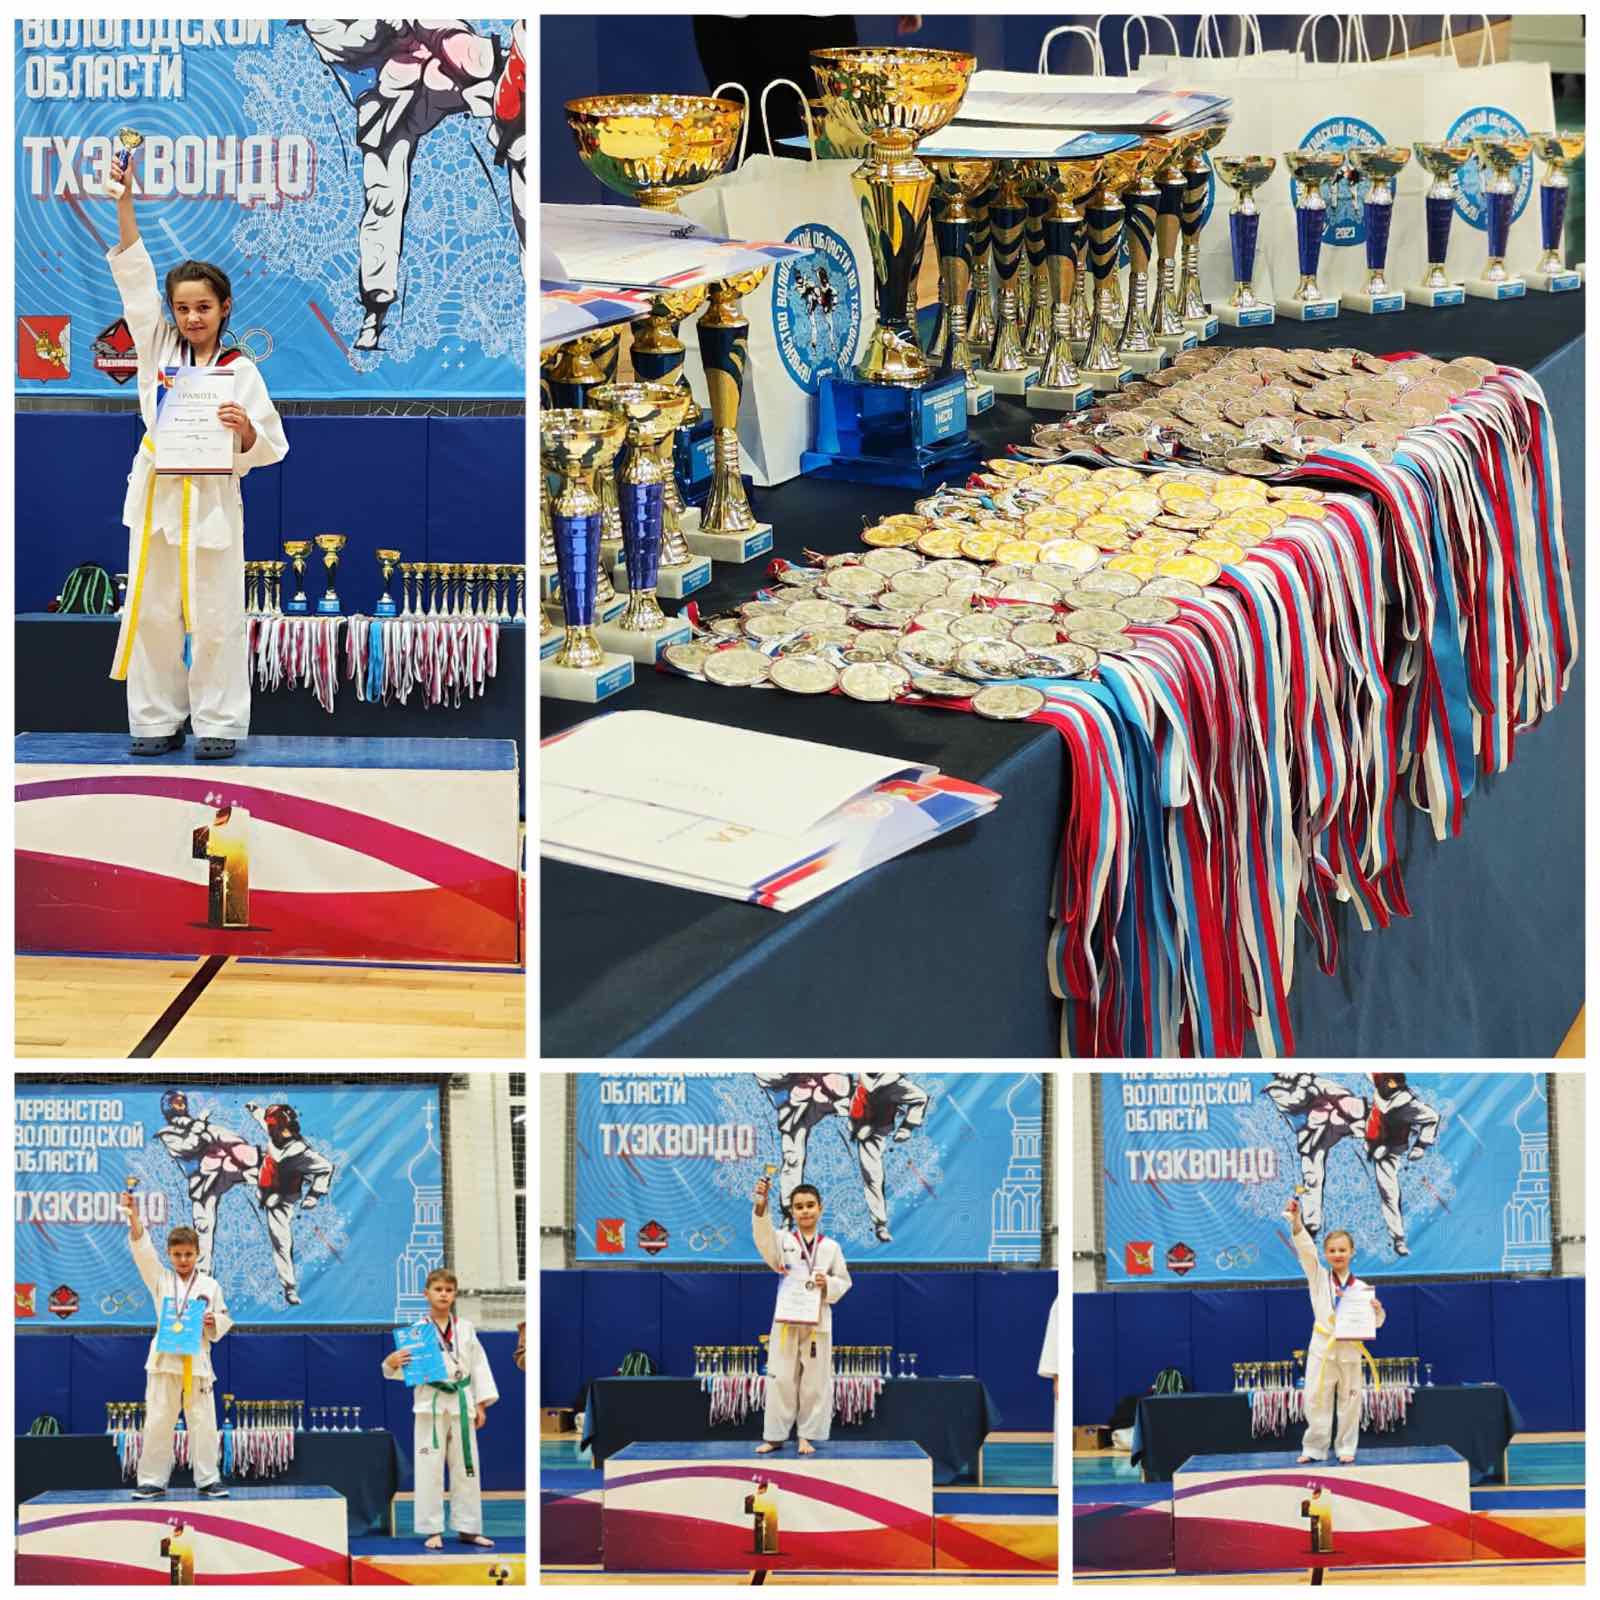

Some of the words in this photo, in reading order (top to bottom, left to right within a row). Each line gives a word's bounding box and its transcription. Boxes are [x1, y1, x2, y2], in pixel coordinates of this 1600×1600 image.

[25, 54, 184, 98] ОБЛАСТИ
[192, 805, 250, 928] 1
[600, 1081, 687, 1105] ОБЛАСТИ
[1122, 1078, 1252, 1108] ВОЛОГОДСКОЙ
[15, 1099, 124, 1121] ПЕРВЕНСТВО
[1125, 1106, 1209, 1132] ОБЛАСТИ
[15, 1122, 145, 1150] ВОЛОГОДСКОЙ
[599, 1123, 755, 1161] ТХЭКВОНДО
[15, 1150, 99, 1173] ОБЛАСТИ
[1125, 1148, 1275, 1183] ТХЭКВОНДО
[744, 1481, 779, 1554] 1
[1301, 1487, 1333, 1553] 1
